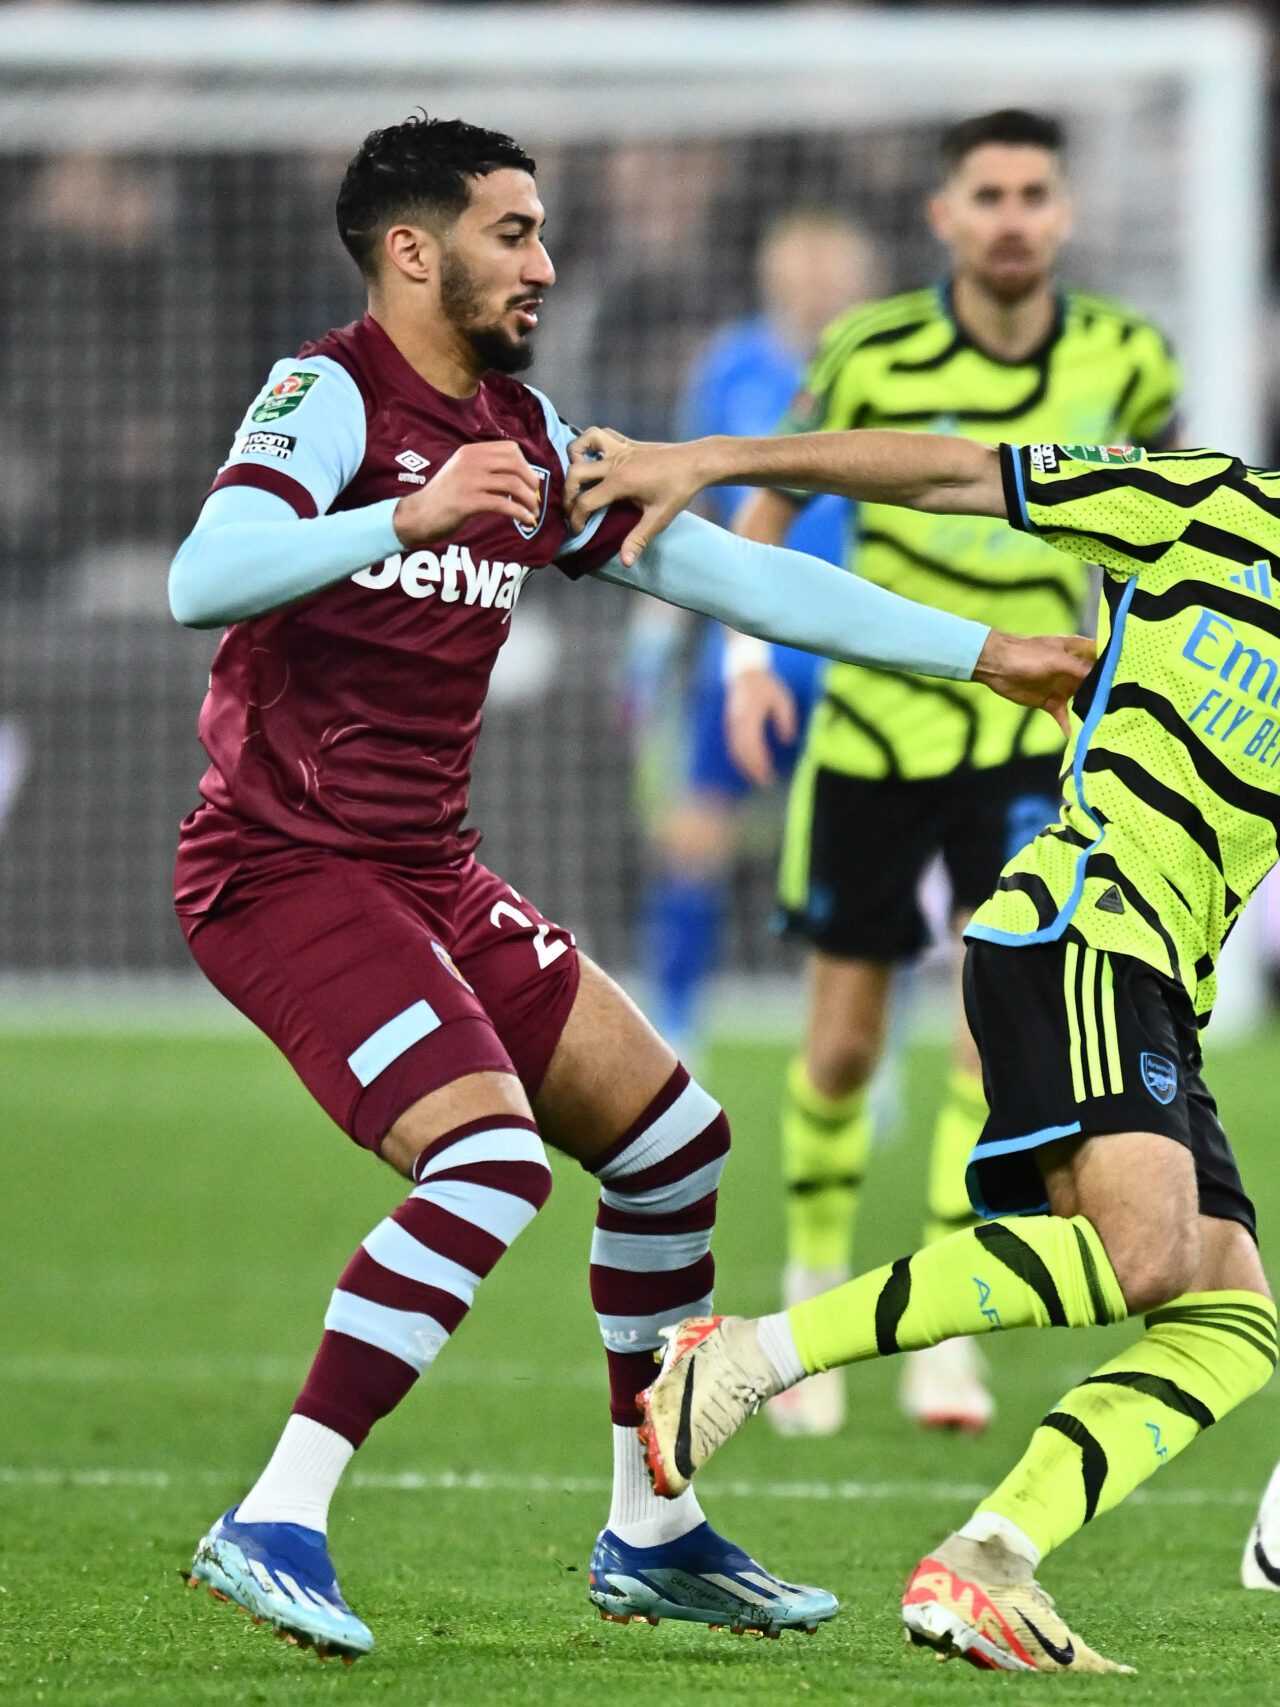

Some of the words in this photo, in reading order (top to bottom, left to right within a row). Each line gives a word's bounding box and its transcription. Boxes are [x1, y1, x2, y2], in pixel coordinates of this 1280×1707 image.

[1187, 688, 1254, 743] FLY
[972, 1276, 1002, 1332] AF
[1145, 1421, 1168, 1465] AF
